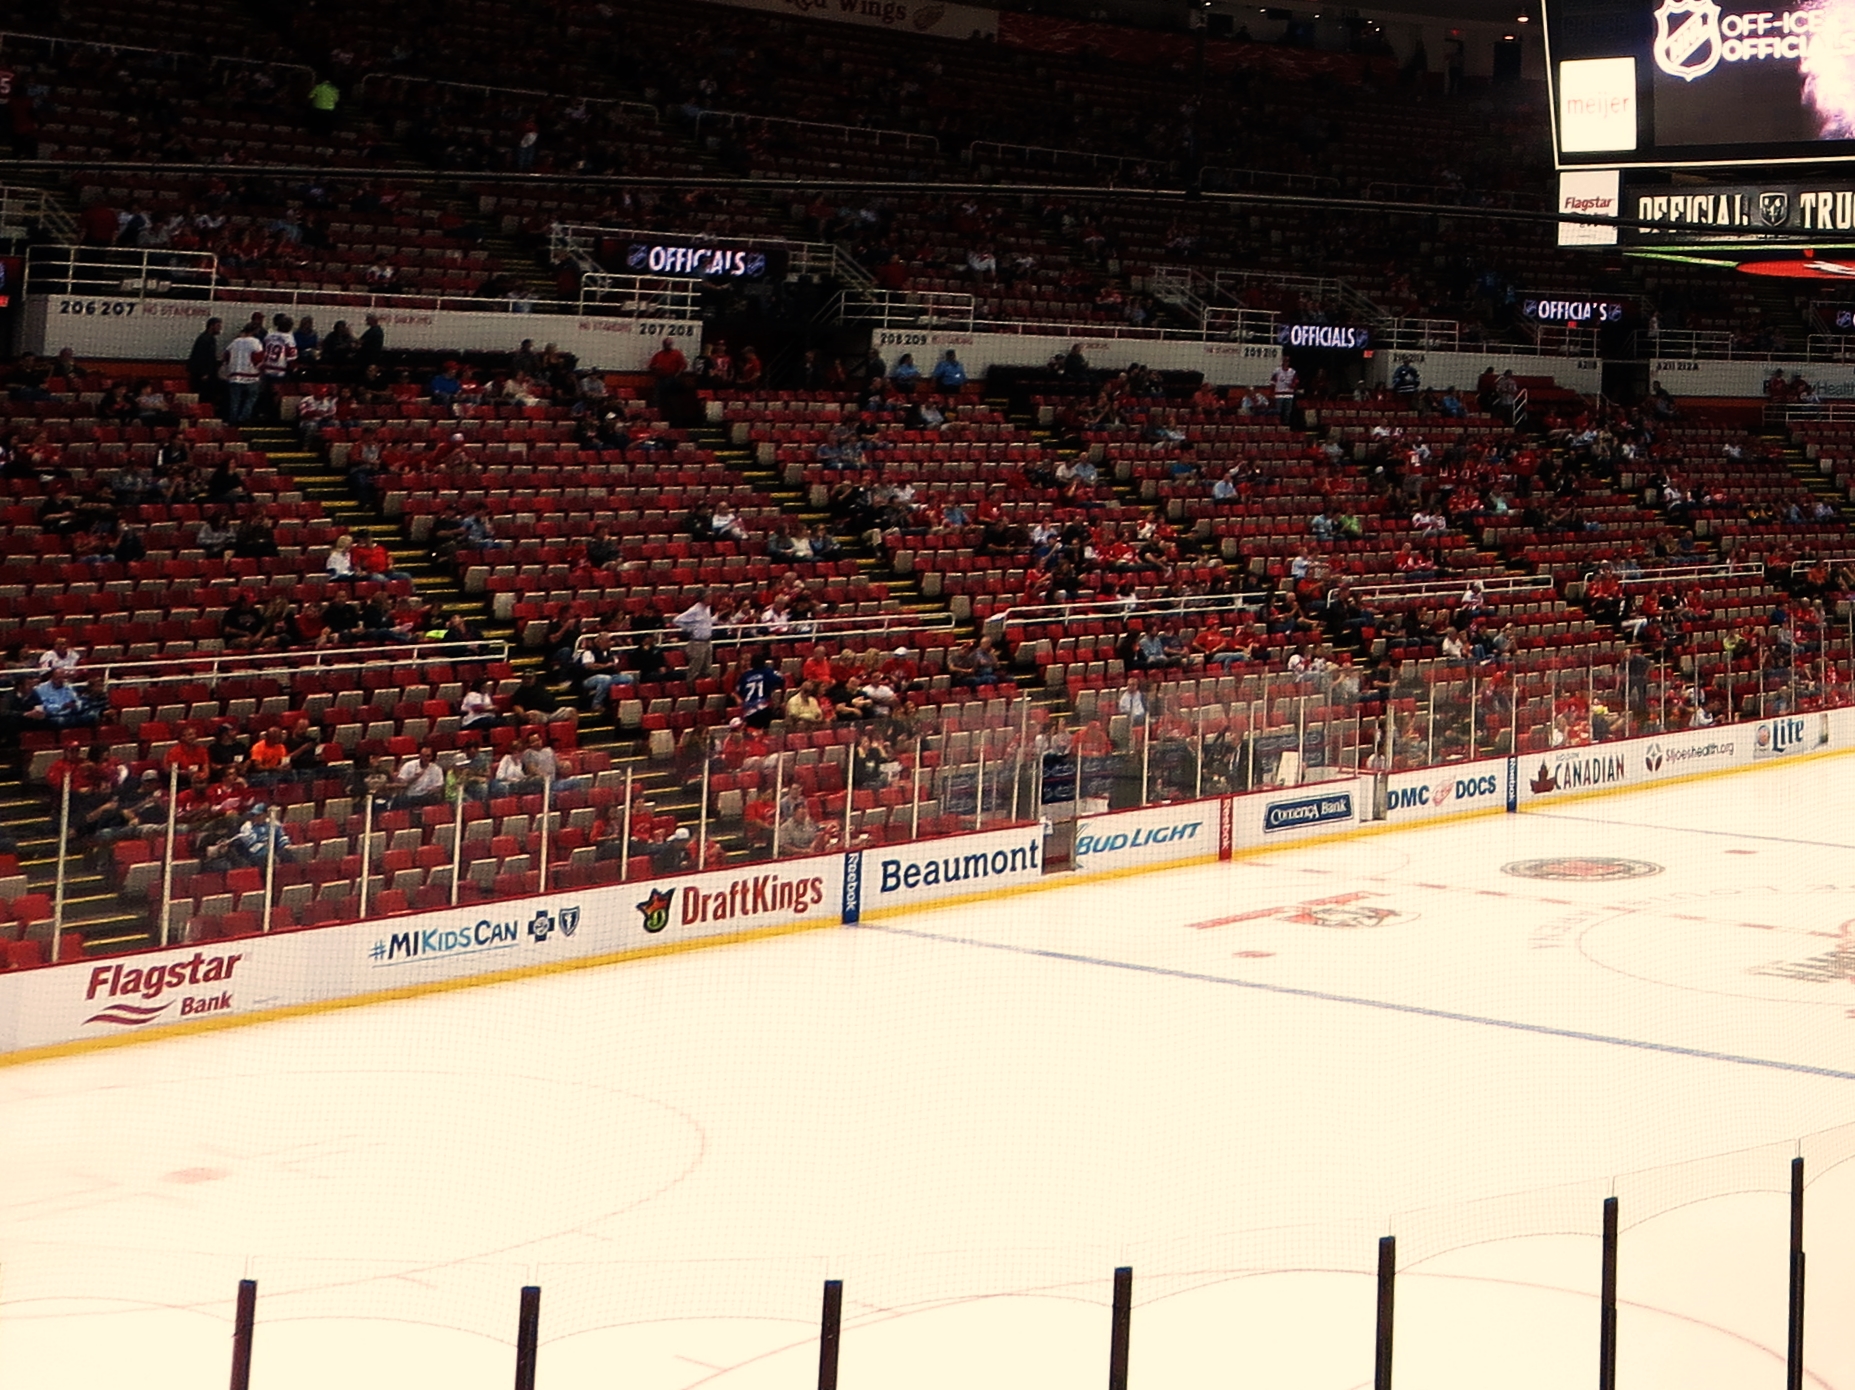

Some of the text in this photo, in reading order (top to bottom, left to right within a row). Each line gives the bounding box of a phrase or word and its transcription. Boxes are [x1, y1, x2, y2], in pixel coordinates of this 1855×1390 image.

[1722, 11, 1824, 37] OFF-ICE
[1568, 97, 1629, 118] meijer
[1564, 196, 1613, 211] Flagstar
[60, 300, 97, 315] 206
[101, 301, 136, 316] 207
[639, 322, 666, 337] 207
[1290, 325, 1355, 349] OFFICIALS
[1772, 719, 1804, 753] Lite
[1554, 754, 1624, 790] CANADIAN
[1321, 798, 1347, 815] Bank
[1387, 775, 1496, 810] DMC DOCS
[1075, 822, 1203, 856] BUD LIGHT
[846, 851, 858, 911] Reebok
[879, 838, 1040, 894] Beaumont
[681, 874, 824, 926] DraftKings
[85, 951, 243, 1001] Flagstar
[181, 991, 233, 1016] Bank
